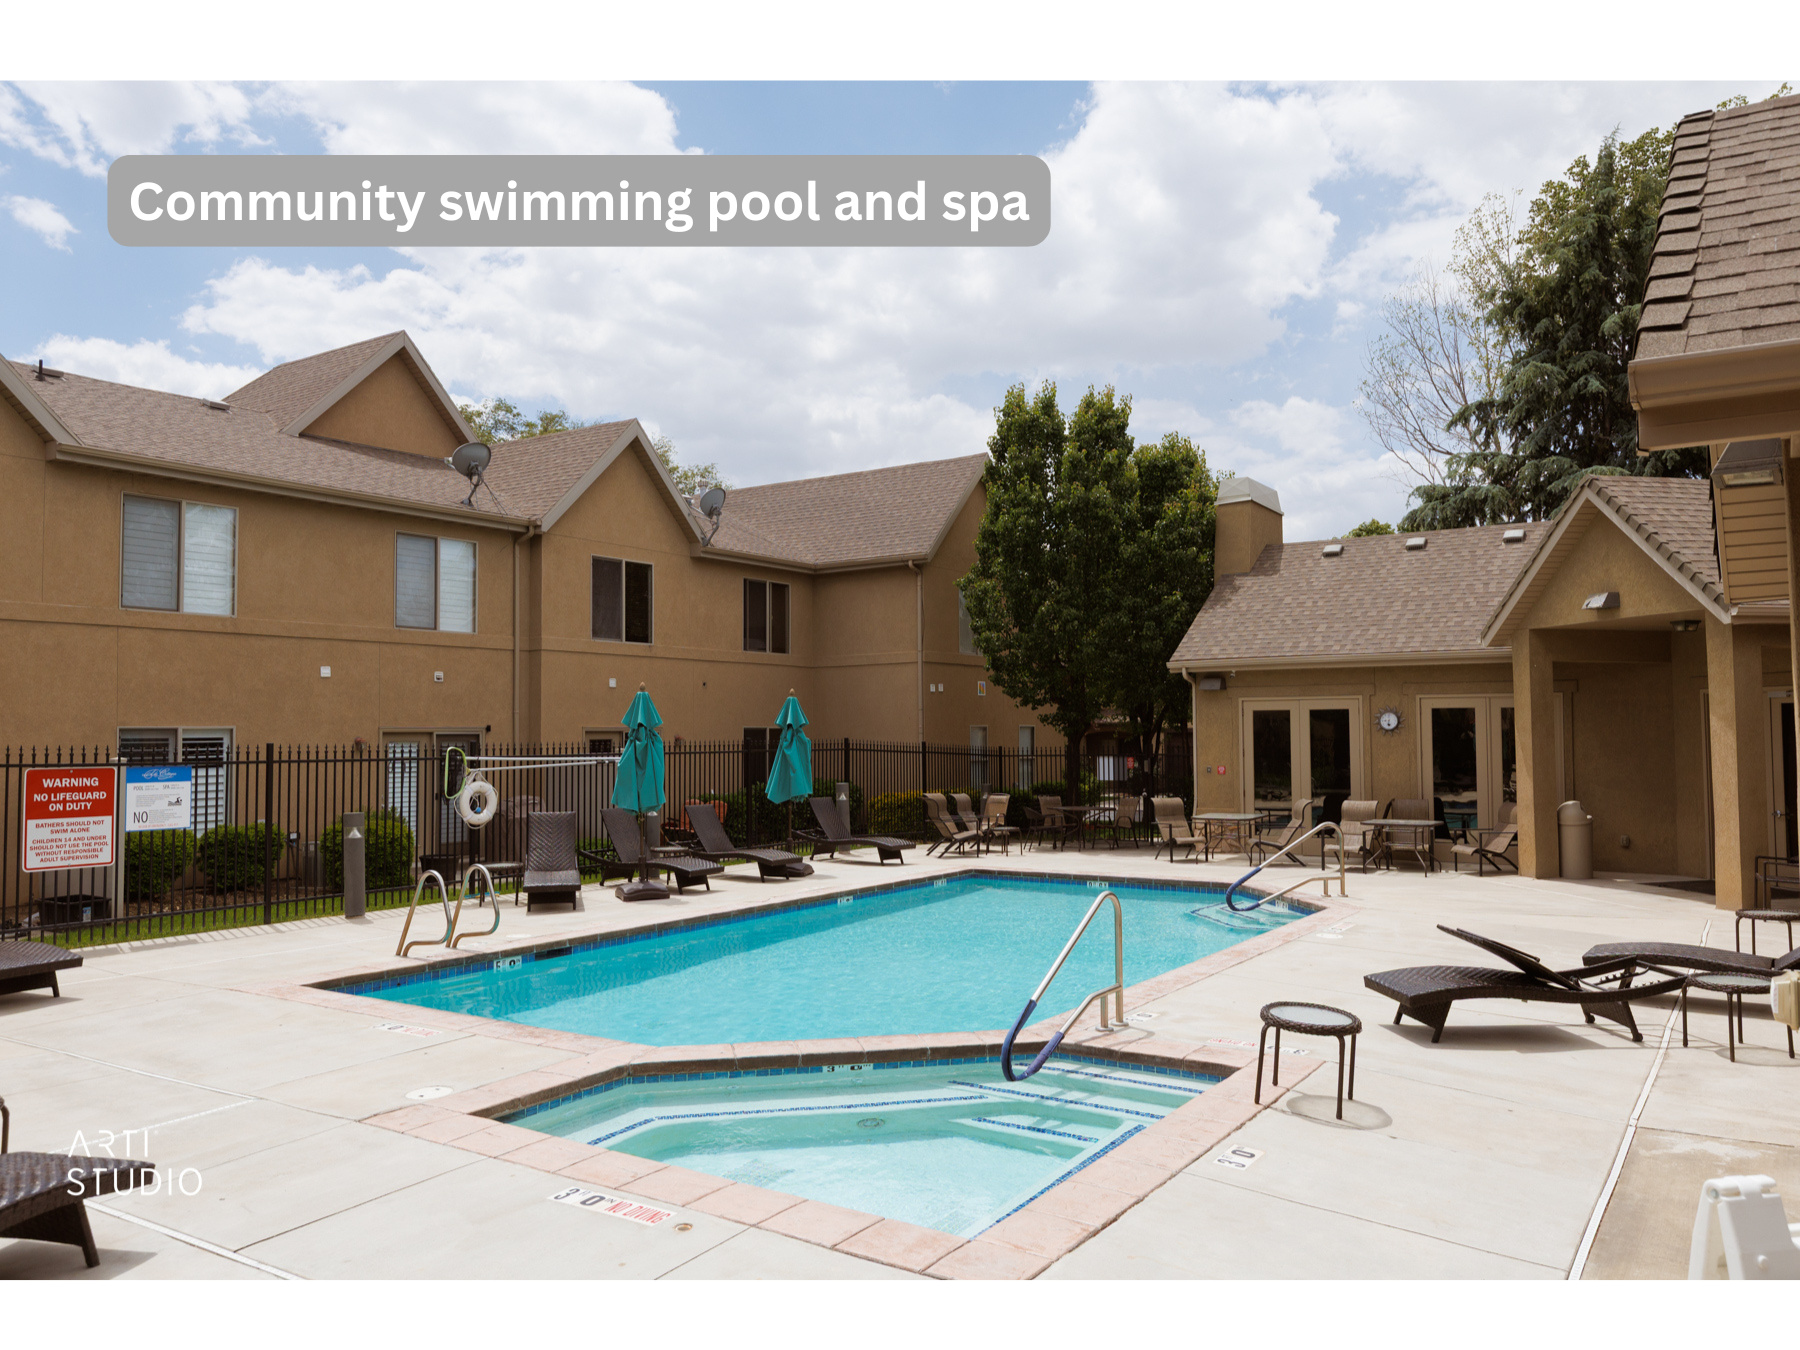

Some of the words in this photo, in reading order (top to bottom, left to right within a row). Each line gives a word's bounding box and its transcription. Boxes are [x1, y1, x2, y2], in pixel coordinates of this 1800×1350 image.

[42, 777, 99, 788] WARNING
[33, 793, 48, 802] NO
[51, 791, 106, 801] LIFEGUARD
[48, 802, 63, 812] ON
[66, 802, 92, 811] DUTY
[133, 810, 148, 824] NO
[1231, 1149, 1255, 1159] 0
[1217, 1158, 1246, 1168] 3
[554, 1188, 580, 1200] 3
[580, 1195, 606, 1206] 0
[604, 1201, 632, 1213] NO
[622, 1205, 671, 1224] DIVING
